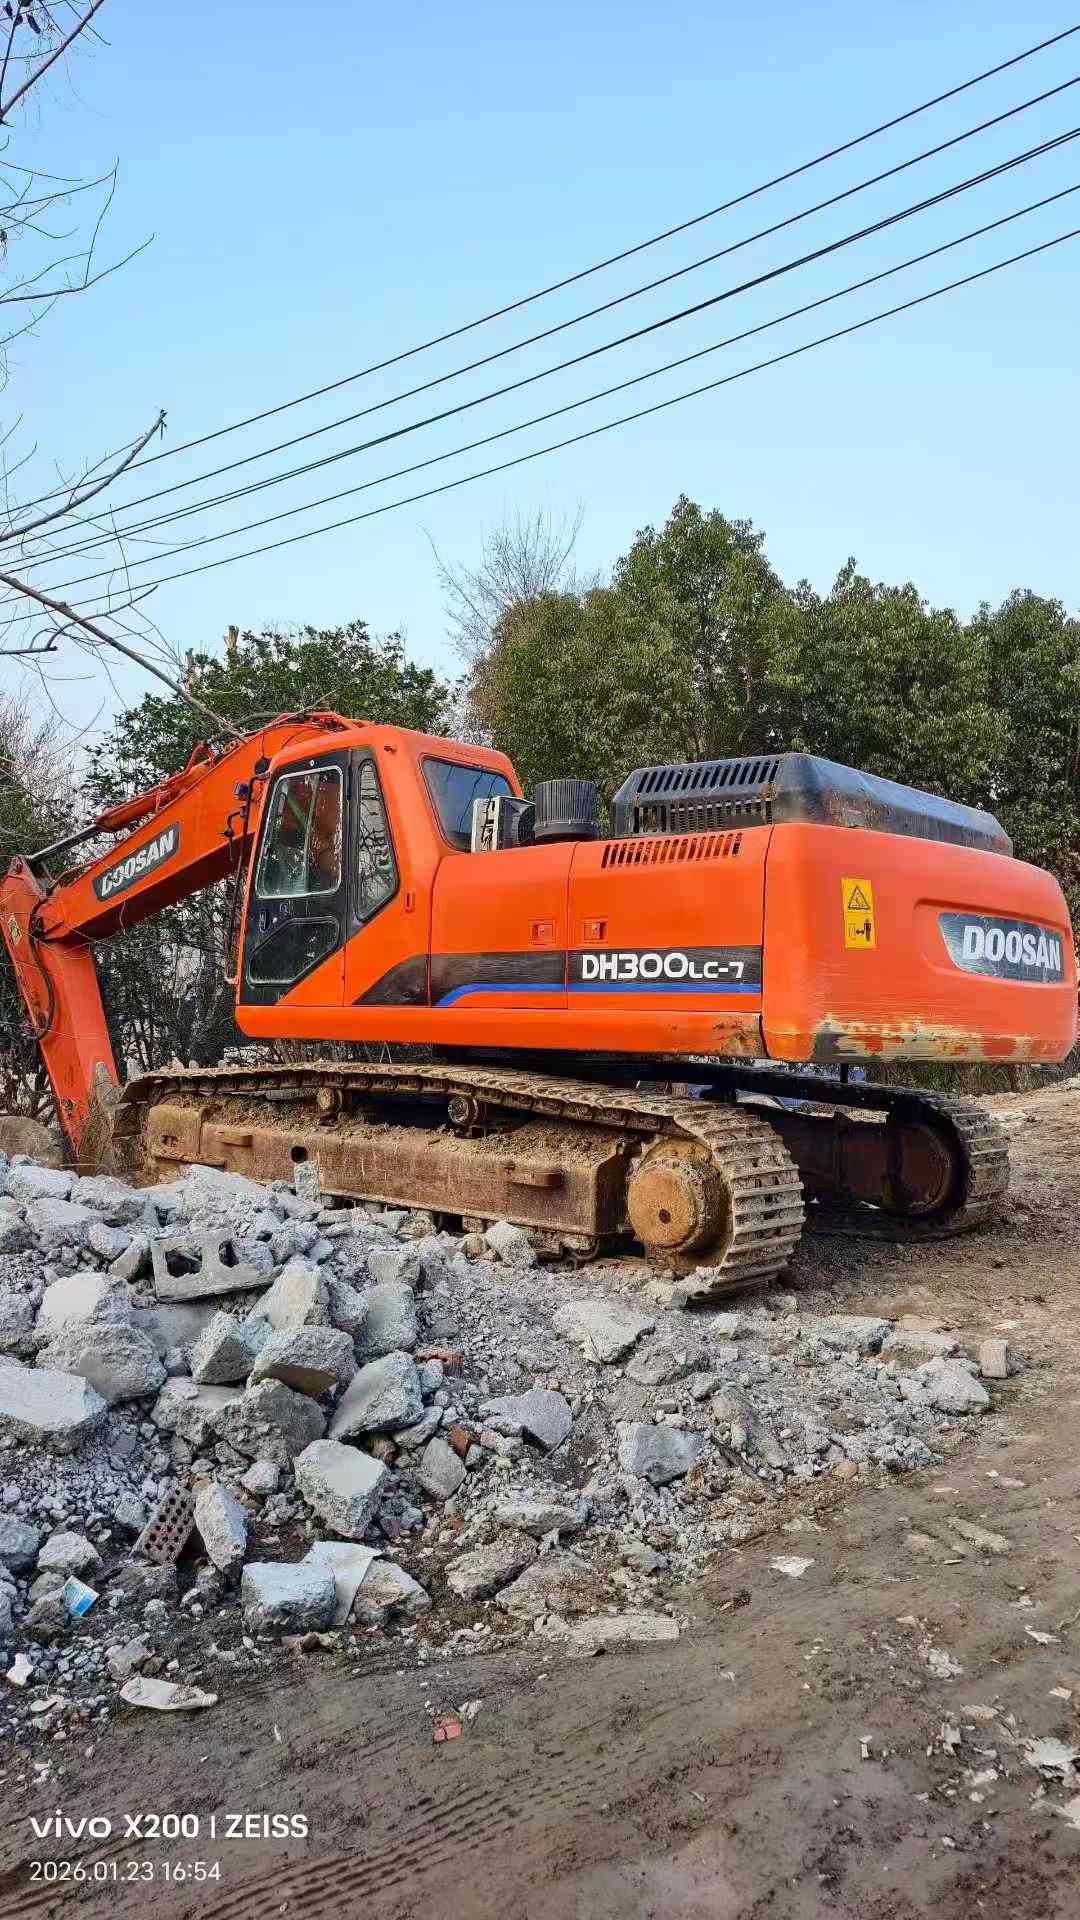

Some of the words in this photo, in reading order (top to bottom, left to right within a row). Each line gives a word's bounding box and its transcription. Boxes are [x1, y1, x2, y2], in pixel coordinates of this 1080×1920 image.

[101, 829, 174, 897] DOOSAN
[582, 952, 745, 979] DH300LC-7
[962, 925, 1060, 971] DOOSAN
